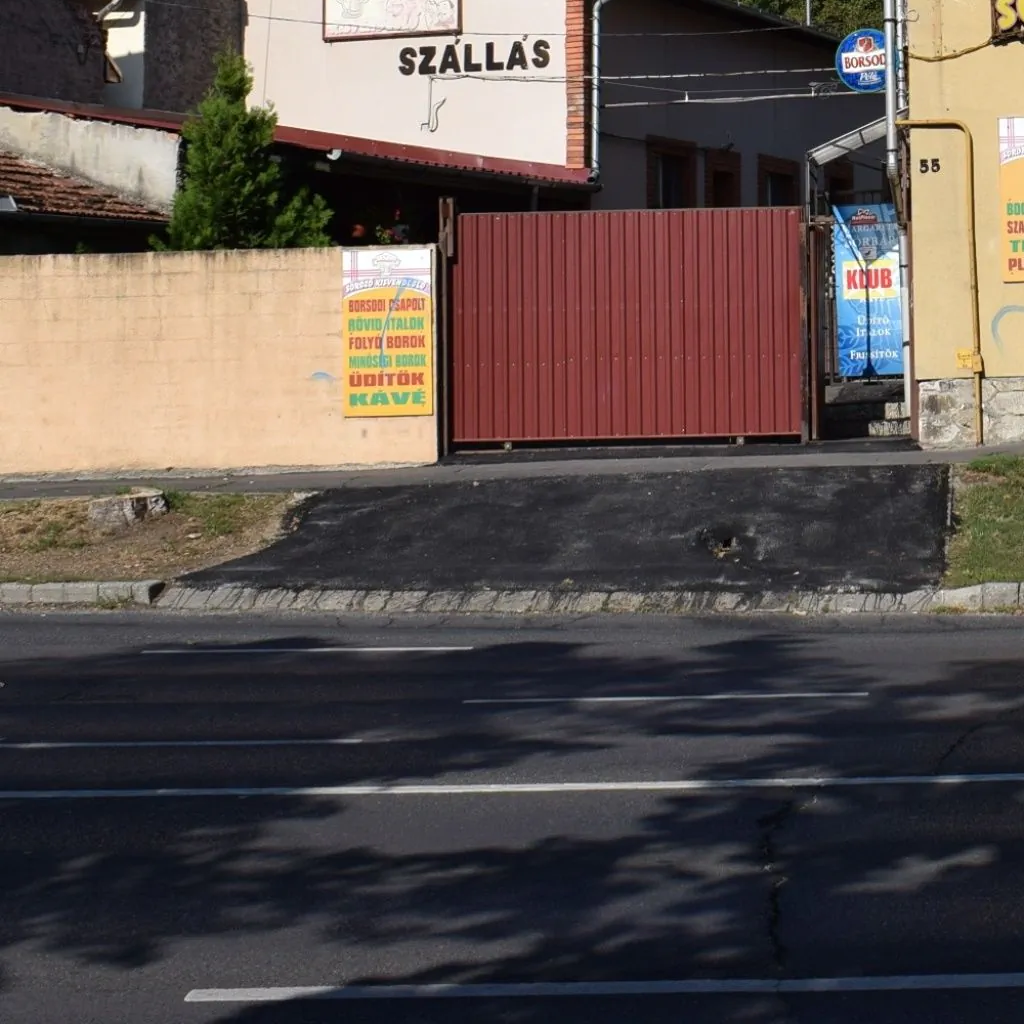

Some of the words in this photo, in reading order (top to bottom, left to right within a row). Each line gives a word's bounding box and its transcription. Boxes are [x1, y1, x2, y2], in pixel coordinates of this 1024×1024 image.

[398, 34, 551, 76] SZÁLLÁS
[844, 51, 886, 70] BORSOD
[919, 158, 941, 174] 55
[846, 267, 893, 290] KLUB
[348, 299, 386, 313] BORSODI
[389, 297, 426, 312] CSAPOLT
[348, 316, 383, 332] RÖVID
[386, 317, 425, 331] ITALOK
[856, 327, 891, 337] ITLOK
[348, 334, 383, 350] FOLYÓ
[386, 335, 426, 349] BOROK
[395, 353, 427, 367] BOROK
[348, 370, 425, 387] ÜDÍTŐK
[348, 389, 427, 407] KÁVÉ
